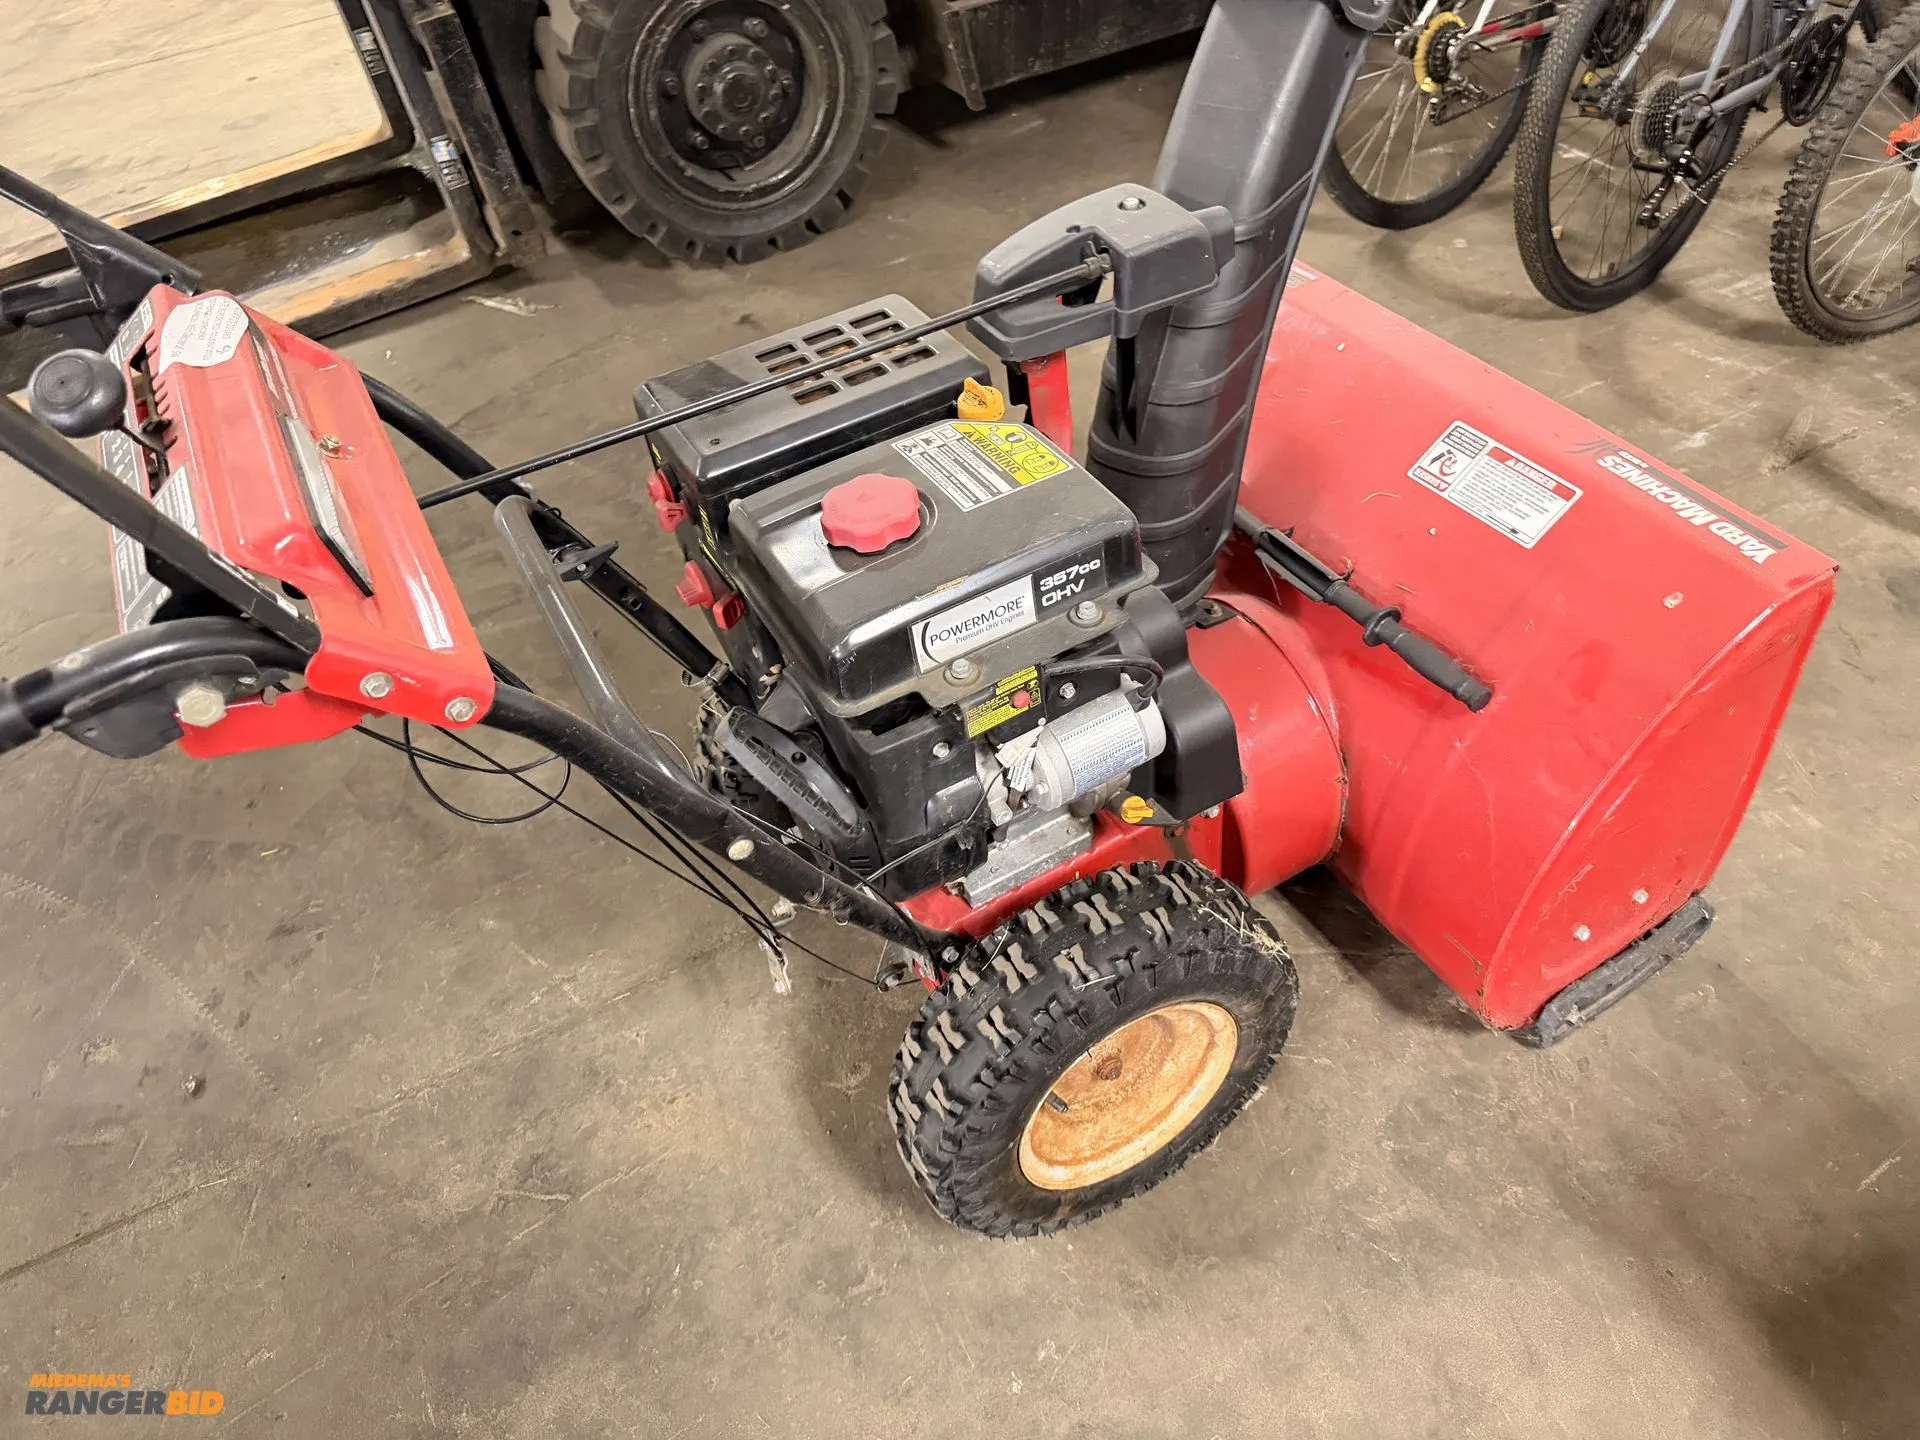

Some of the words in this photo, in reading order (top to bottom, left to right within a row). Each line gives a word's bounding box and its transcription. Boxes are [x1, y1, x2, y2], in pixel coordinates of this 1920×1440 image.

[973, 436, 1021, 474] WARNING
[1597, 455, 1719, 526] MACHINES
[1708, 521, 1777, 565] YARD
[1040, 559, 1101, 591] 357cc
[1041, 578, 1085, 607] OHV
[930, 597, 1024, 646] POWERMORE
[955, 626, 985, 644] Premium
[985, 619, 999, 632] OHV
[1000, 609, 1025, 625] Engines
